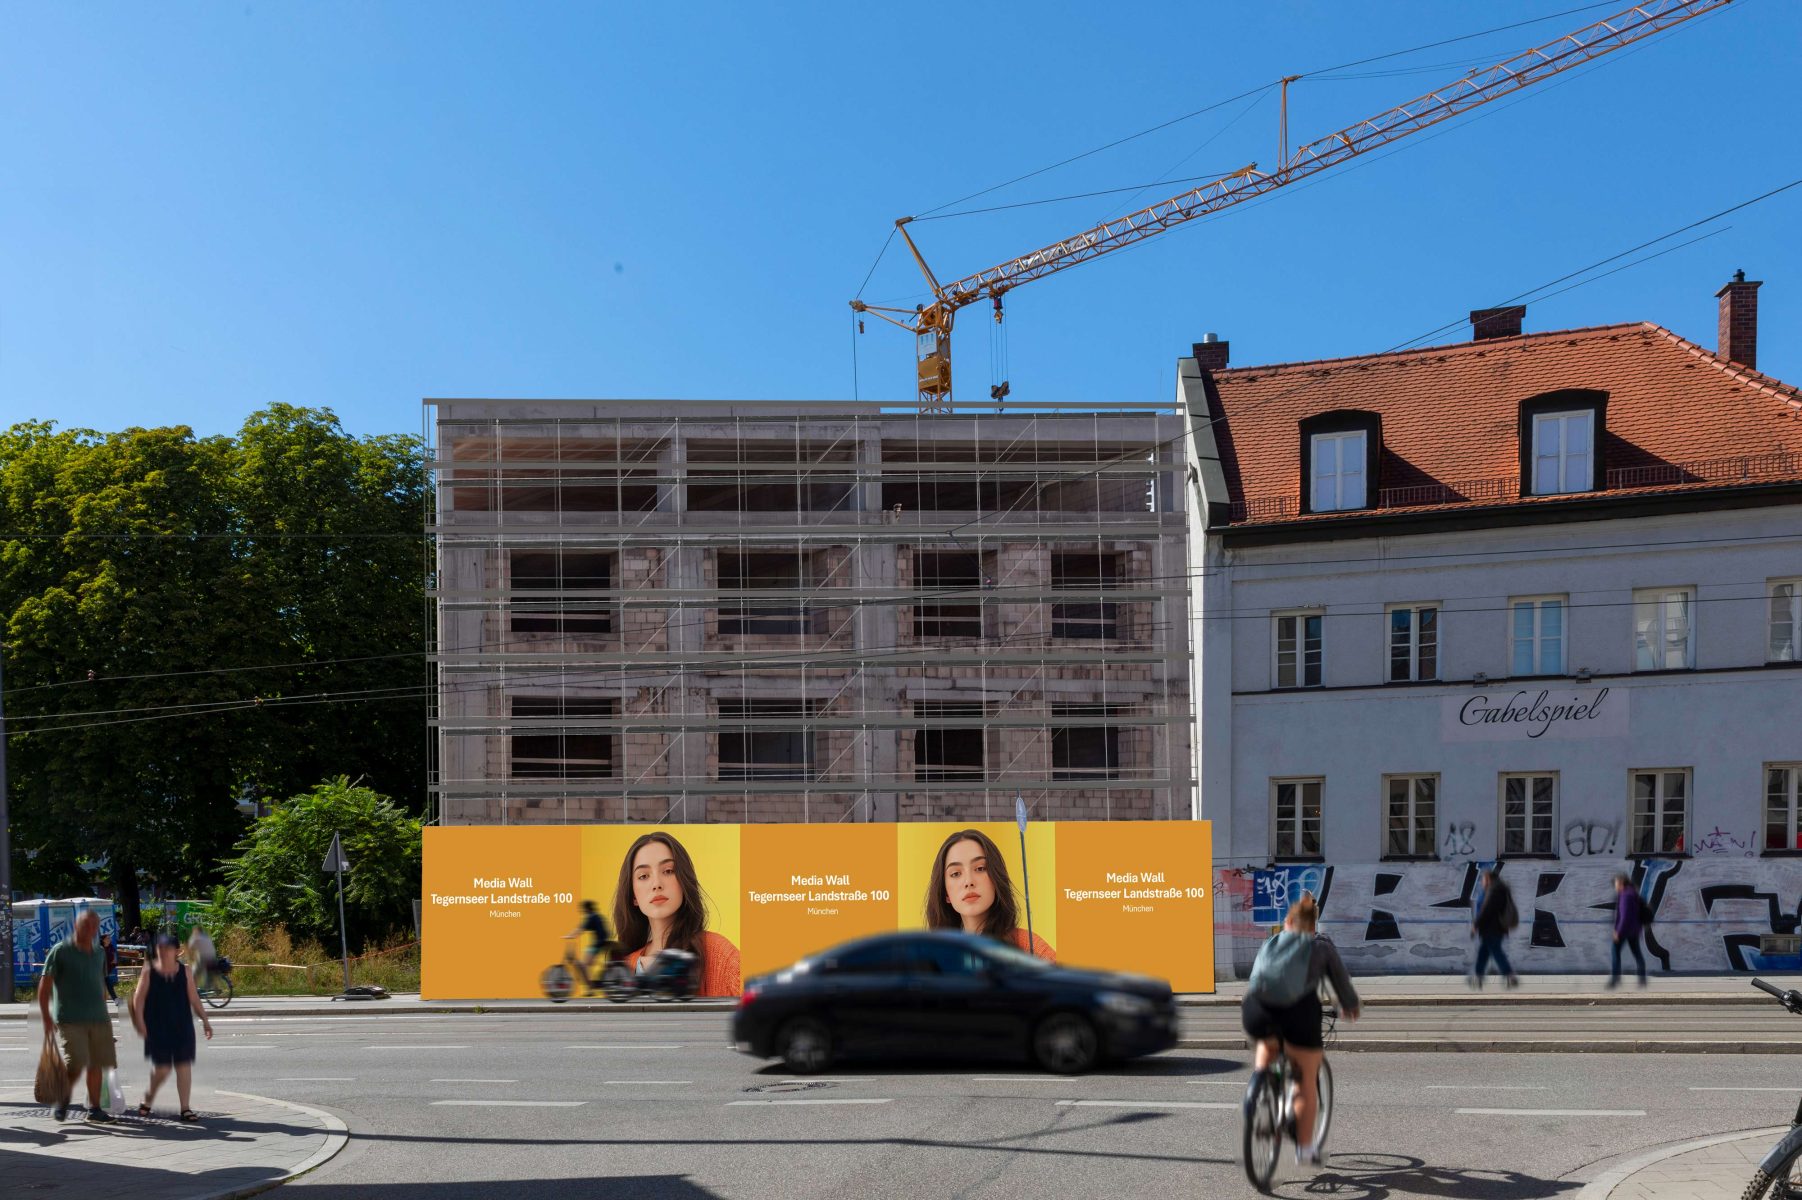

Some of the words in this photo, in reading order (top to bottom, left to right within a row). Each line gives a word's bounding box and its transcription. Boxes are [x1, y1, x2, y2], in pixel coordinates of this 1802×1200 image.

[1459, 687, 1609, 738] Gabelspiel
[473, 877, 506, 888] Media
[508, 877, 533, 888] Wall
[791, 874, 824, 886] Media
[825, 874, 850, 886] Wall
[1106, 871, 1138, 883] Media
[1140, 871, 1165, 883] Wall
[430, 893, 488, 906] Tegernseer
[490, 892, 550, 904] Landstraße
[554, 892, 573, 903] 100
[748, 891, 807, 904] Tegernseer
[808, 890, 868, 902] Landstraße
[870, 889, 890, 901] 100
[1064, 888, 1122, 901] Tegernseer
[1123, 886, 1182, 899] Landstraße
[1185, 886, 1204, 898] 100
[489, 910, 521, 918] München
[807, 907, 839, 915] München
[1122, 904, 1154, 913] München
